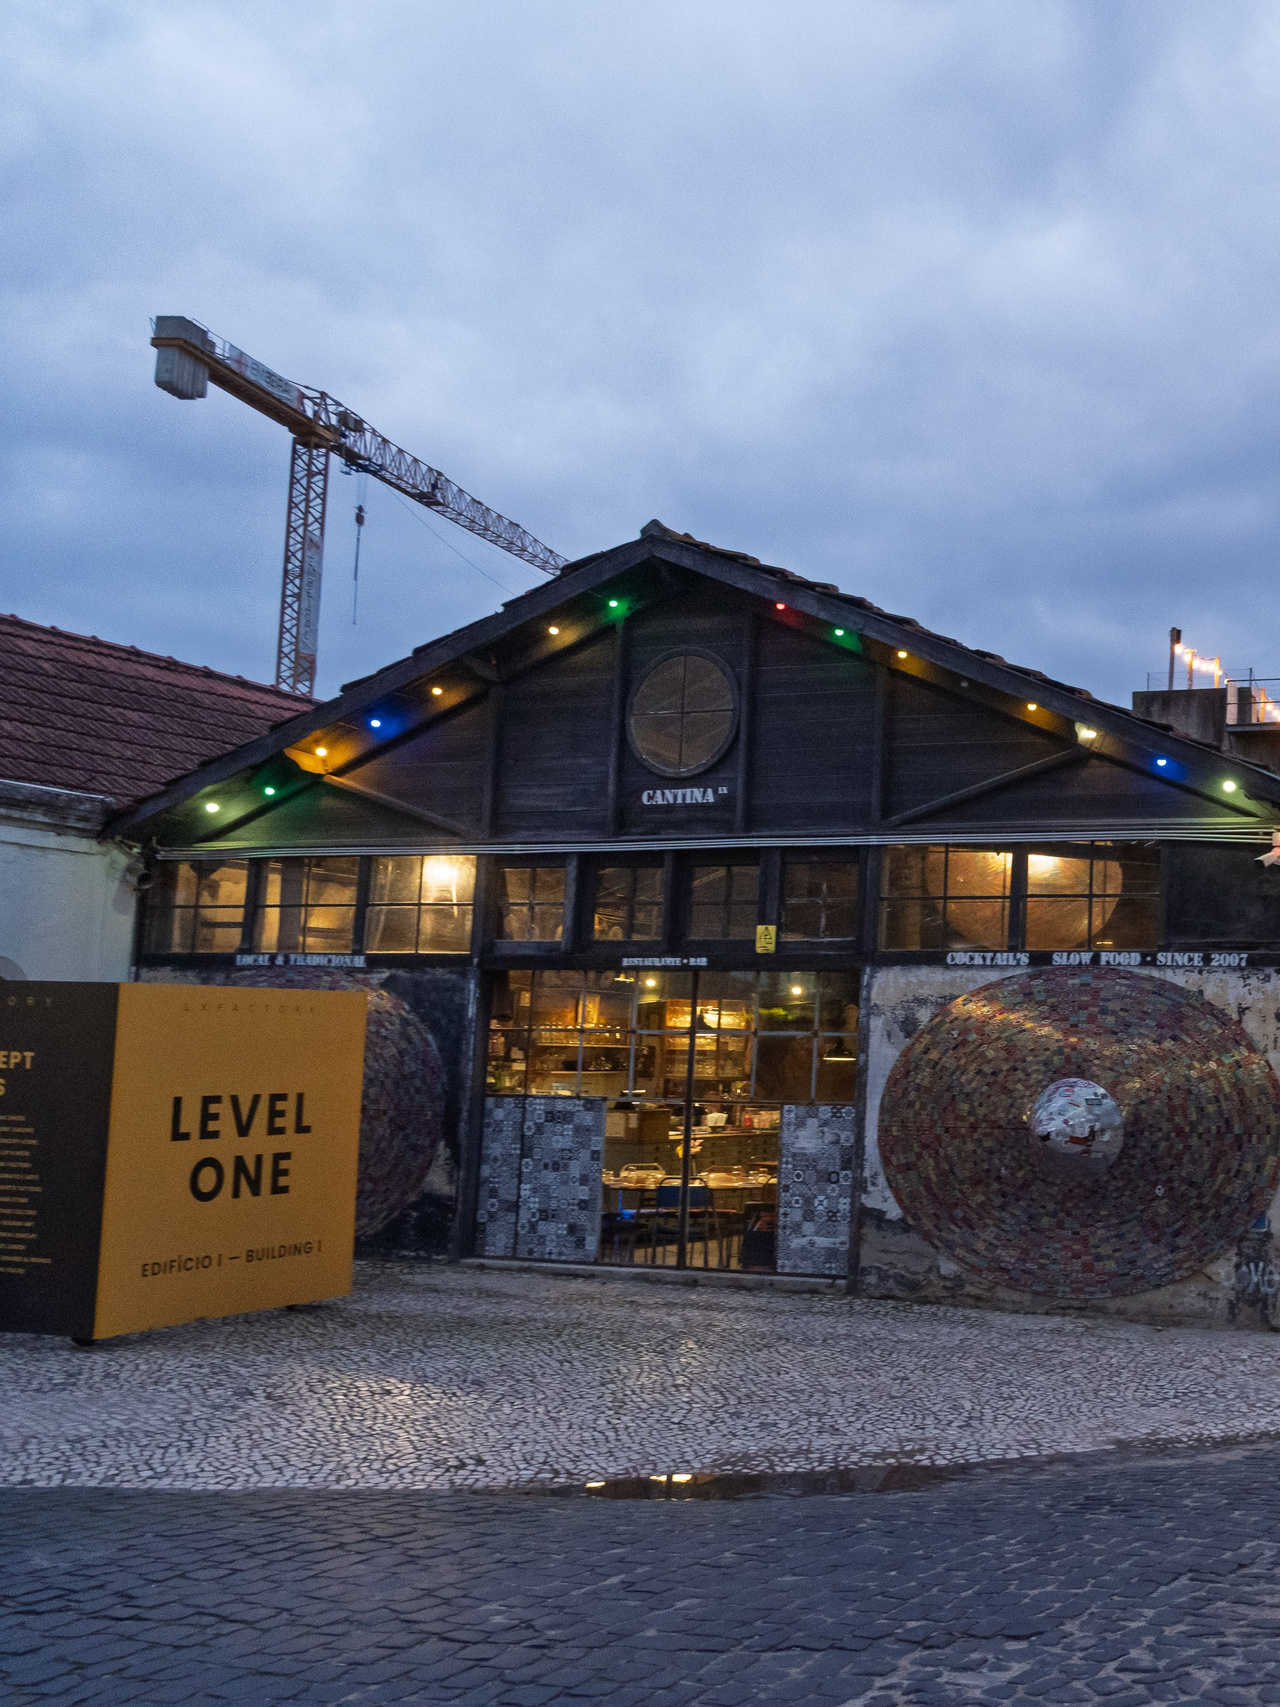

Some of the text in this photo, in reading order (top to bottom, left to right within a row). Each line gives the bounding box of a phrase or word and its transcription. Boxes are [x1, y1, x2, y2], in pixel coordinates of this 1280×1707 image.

[641, 788, 715, 805] CANTINA
[235, 954, 271, 966] LOCAL
[689, 957, 708, 966] BAR
[1052, 952, 1095, 966] SLOW
[1100, 952, 1142, 966] FOOD
[1156, 953, 1203, 967] SINCE
[1210, 953, 1249, 967] 2007
[170, 1092, 312, 1142] LEVEL
[189, 1151, 292, 1203] ONE
[141, 1255, 212, 1278] EDIFÍCIO
[245, 1241, 314, 1263] BUILDING
